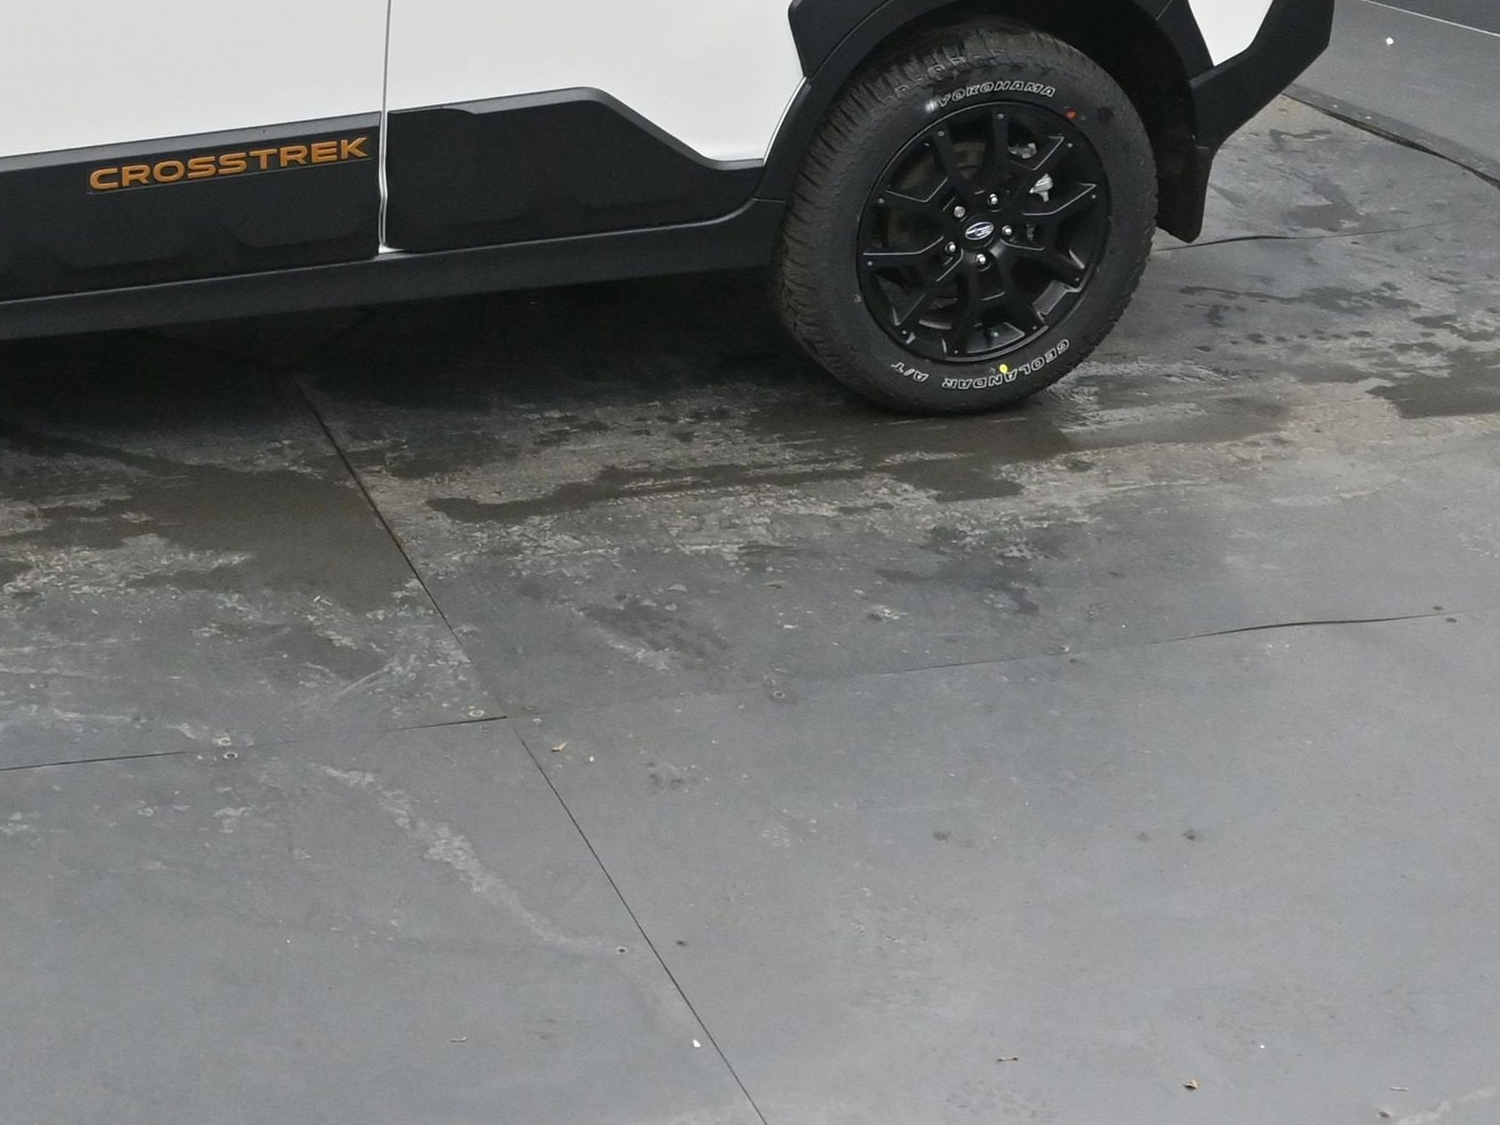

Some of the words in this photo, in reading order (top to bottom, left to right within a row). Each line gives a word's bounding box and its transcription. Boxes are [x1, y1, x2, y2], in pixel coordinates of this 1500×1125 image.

[937, 79, 1056, 108] YOKOHAMA
[89, 137, 368, 191] CROSSTREK
[890, 361, 930, 383] A/T
[941, 339, 1071, 389] GEOLANDAR
